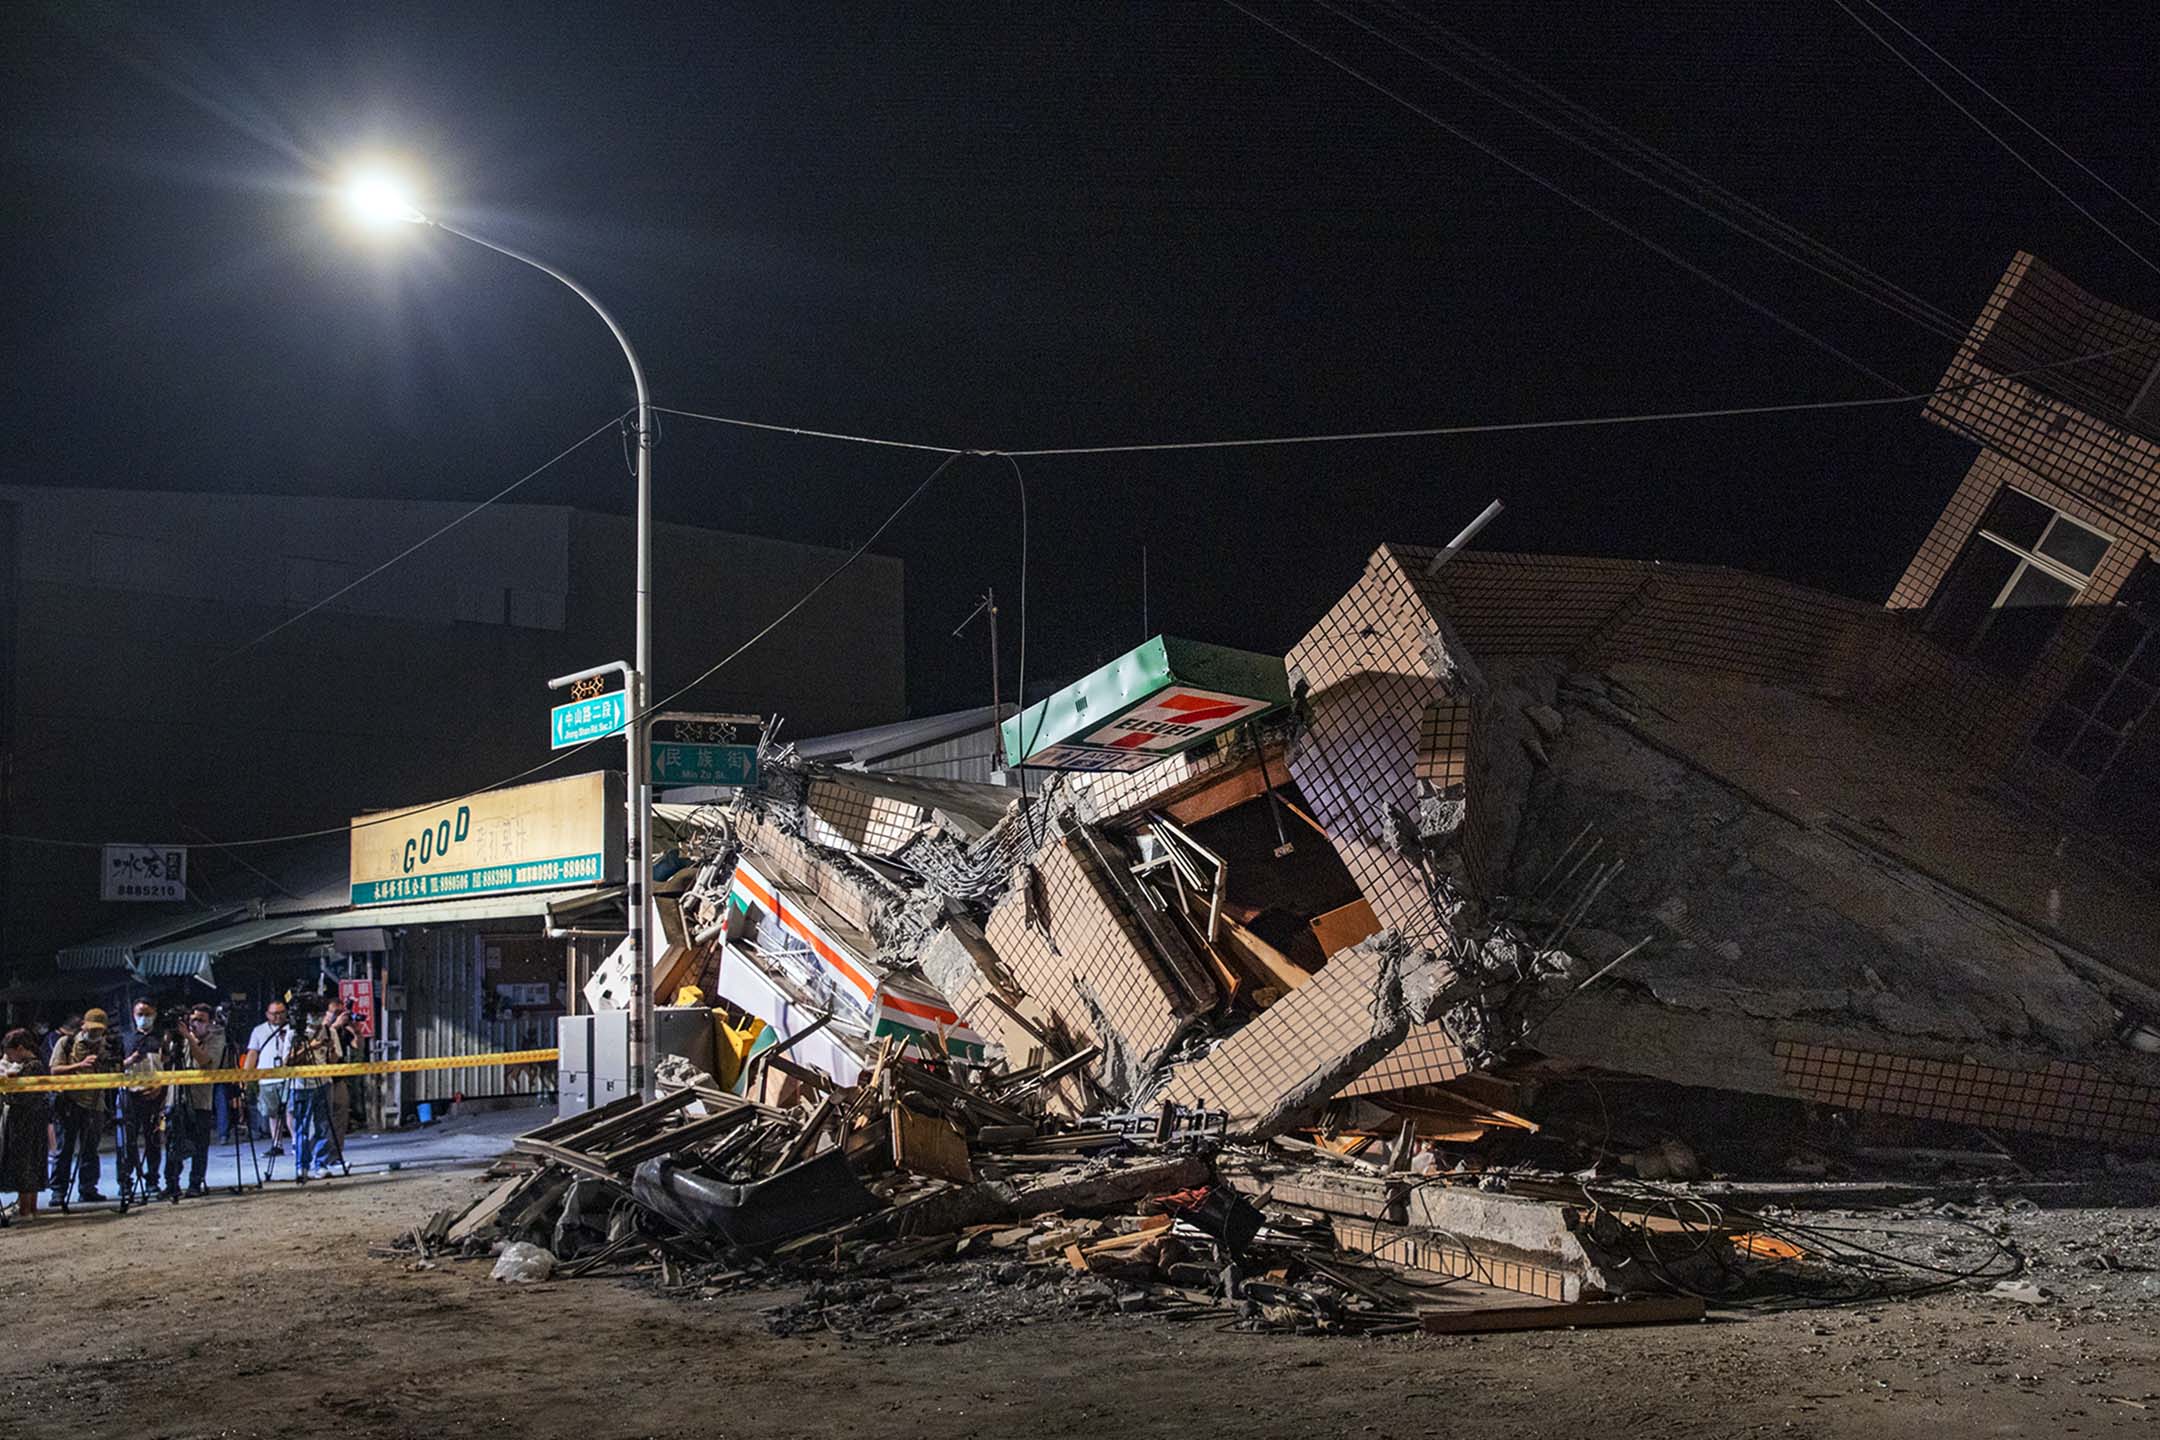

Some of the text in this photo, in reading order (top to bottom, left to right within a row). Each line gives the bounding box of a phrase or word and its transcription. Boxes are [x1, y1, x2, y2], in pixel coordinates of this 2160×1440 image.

[565, 701, 611, 727] 中山路二段
[666, 748, 742, 768] 民族街
[1085, 752, 1115, 761] ATM
[681, 770, 698, 779] Min
[699, 770, 712, 779] Zu
[403, 805, 470, 873] GOOD
